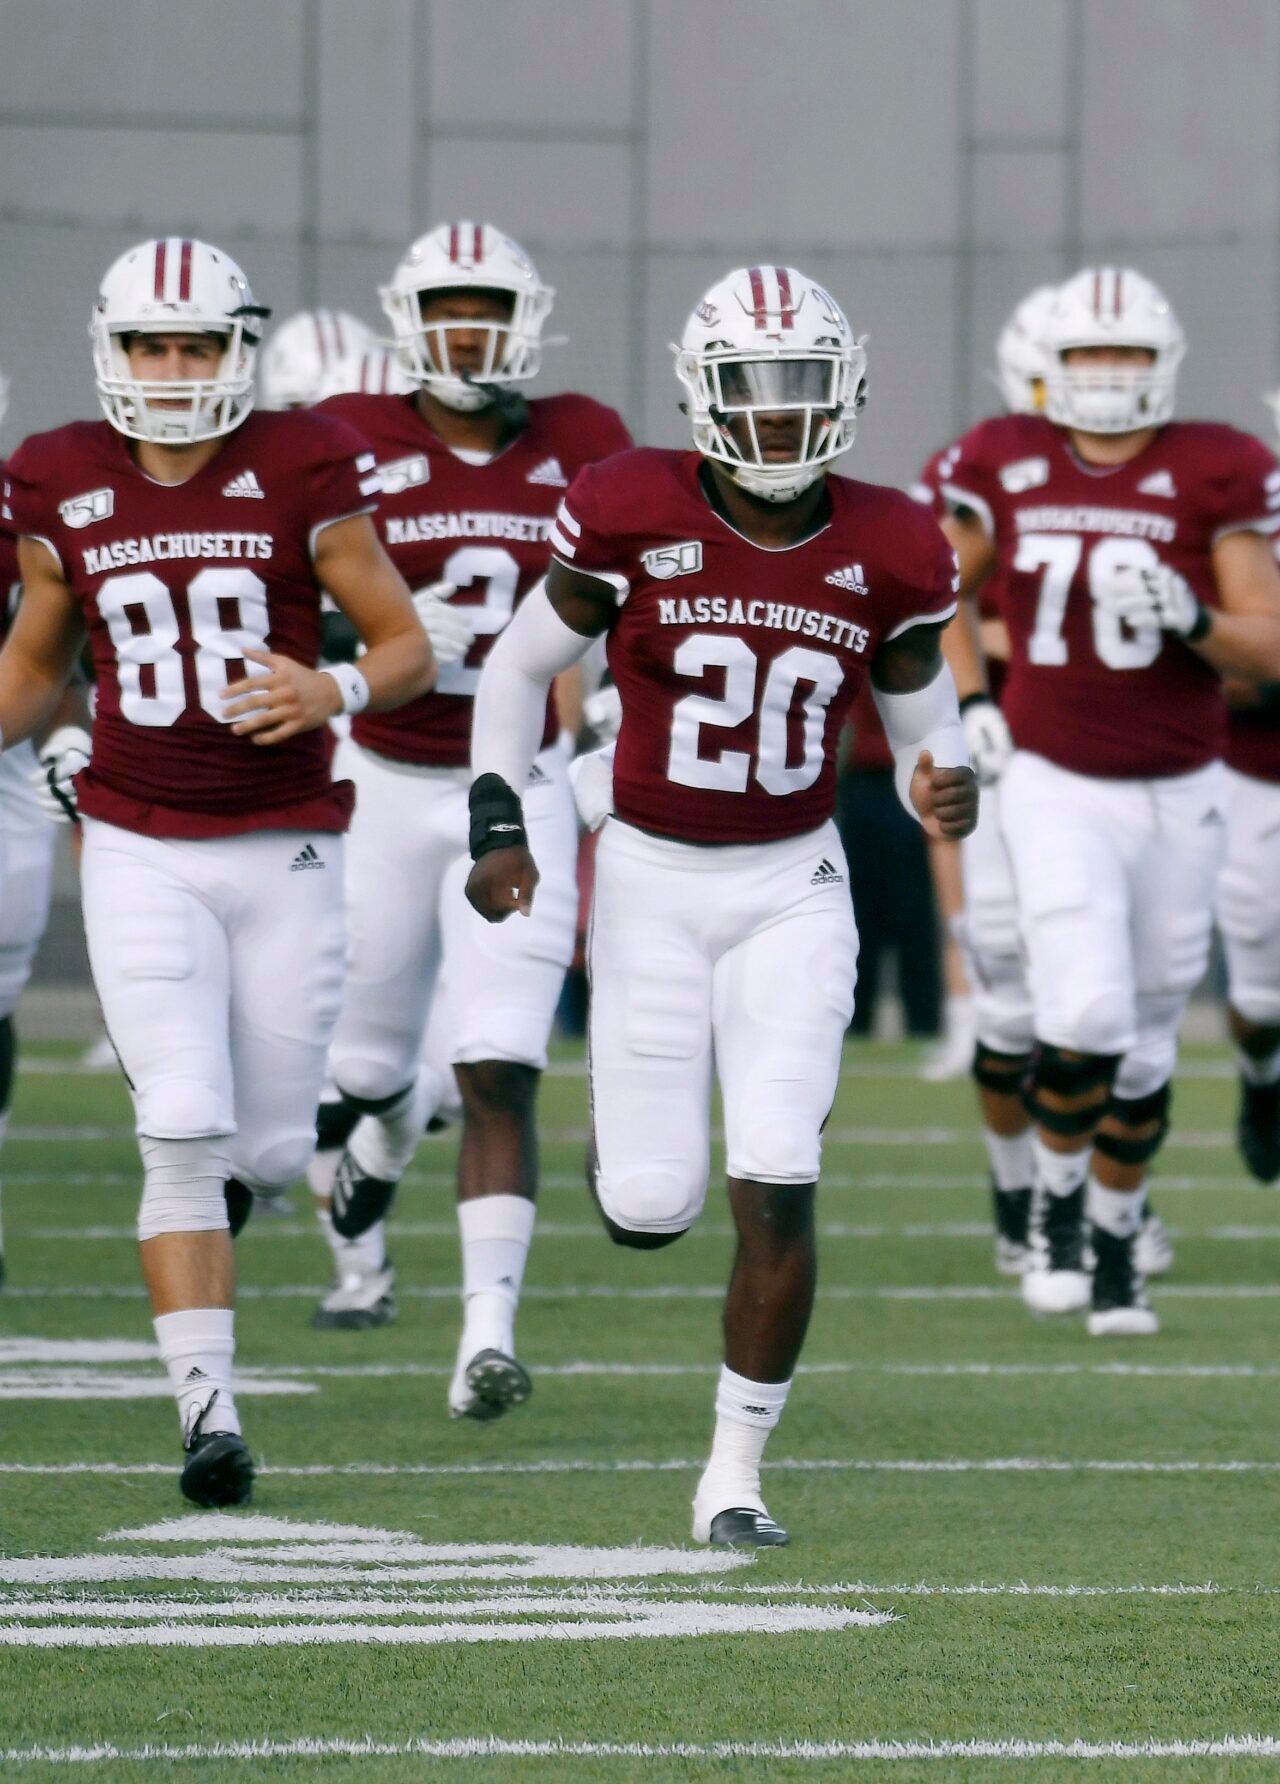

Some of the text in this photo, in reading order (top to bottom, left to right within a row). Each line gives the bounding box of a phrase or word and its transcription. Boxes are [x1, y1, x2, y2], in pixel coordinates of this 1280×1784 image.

[223, 488, 265, 499] adidas
[83, 533, 273, 575] MASSACHUSETTS
[641, 541, 702, 580] 150
[825, 574, 869, 596] adidas
[96, 567, 271, 727] 88
[658, 598, 870, 654] MASSACHUSETTS
[667, 634, 845, 796] 20
